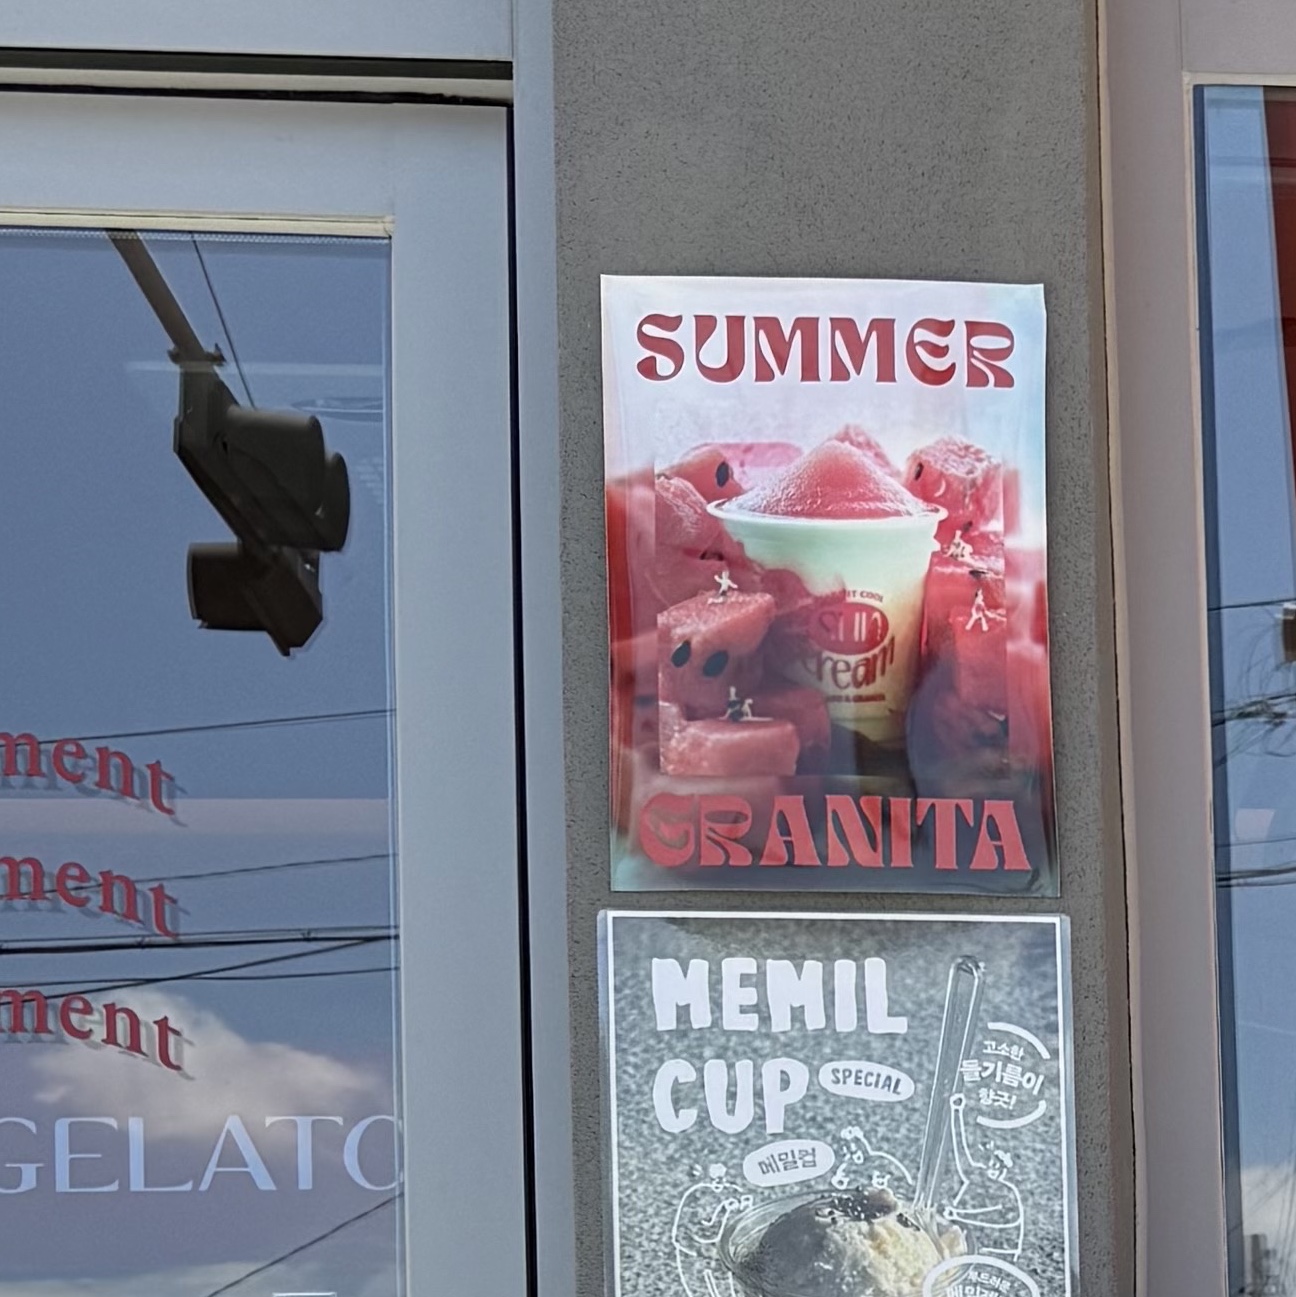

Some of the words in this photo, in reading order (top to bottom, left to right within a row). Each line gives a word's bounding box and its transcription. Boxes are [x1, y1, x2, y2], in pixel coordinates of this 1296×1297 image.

[636, 313, 1015, 389] SUMMER
[639, 792, 1033, 871] GRANITA
[651, 957, 908, 1034] MEMIL
[652, 1057, 810, 1134] CUP
[830, 1067, 902, 1096] SPECIAL
[959, 1058, 1045, 1096] 들기름이
[758, 1147, 818, 1175] 메밀컵
